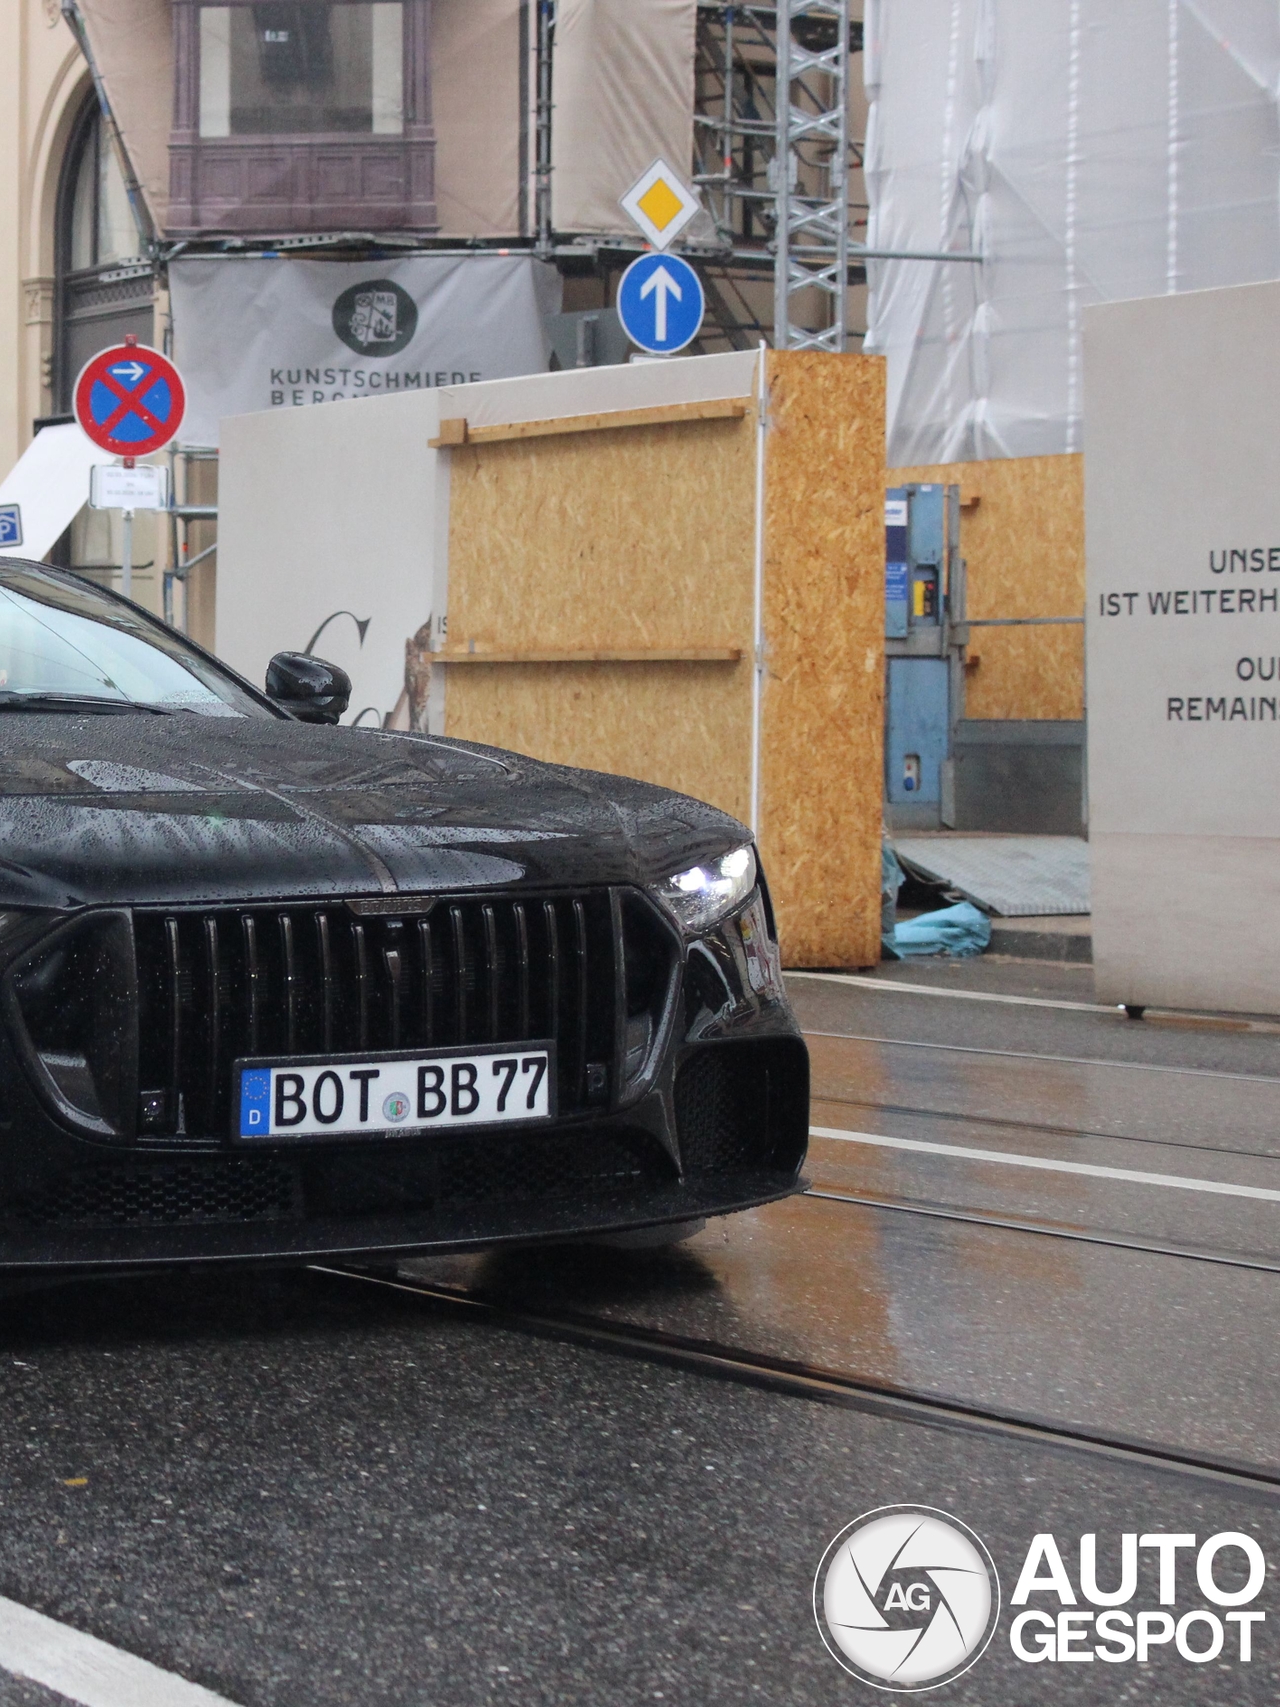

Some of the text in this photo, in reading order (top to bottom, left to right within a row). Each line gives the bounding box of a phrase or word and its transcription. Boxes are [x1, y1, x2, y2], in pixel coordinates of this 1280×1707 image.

[270, 367, 483, 388] KUNSTSCHMIEDE
[1210, 547, 1280, 574] UNSE
[1099, 588, 1277, 616] IST WEITERH
[1236, 656, 1280, 681] OU
[1167, 696, 1280, 721] REMAIN
[274, 1056, 548, 1127] BOT BB 77
[248, 1109, 261, 1126] D
